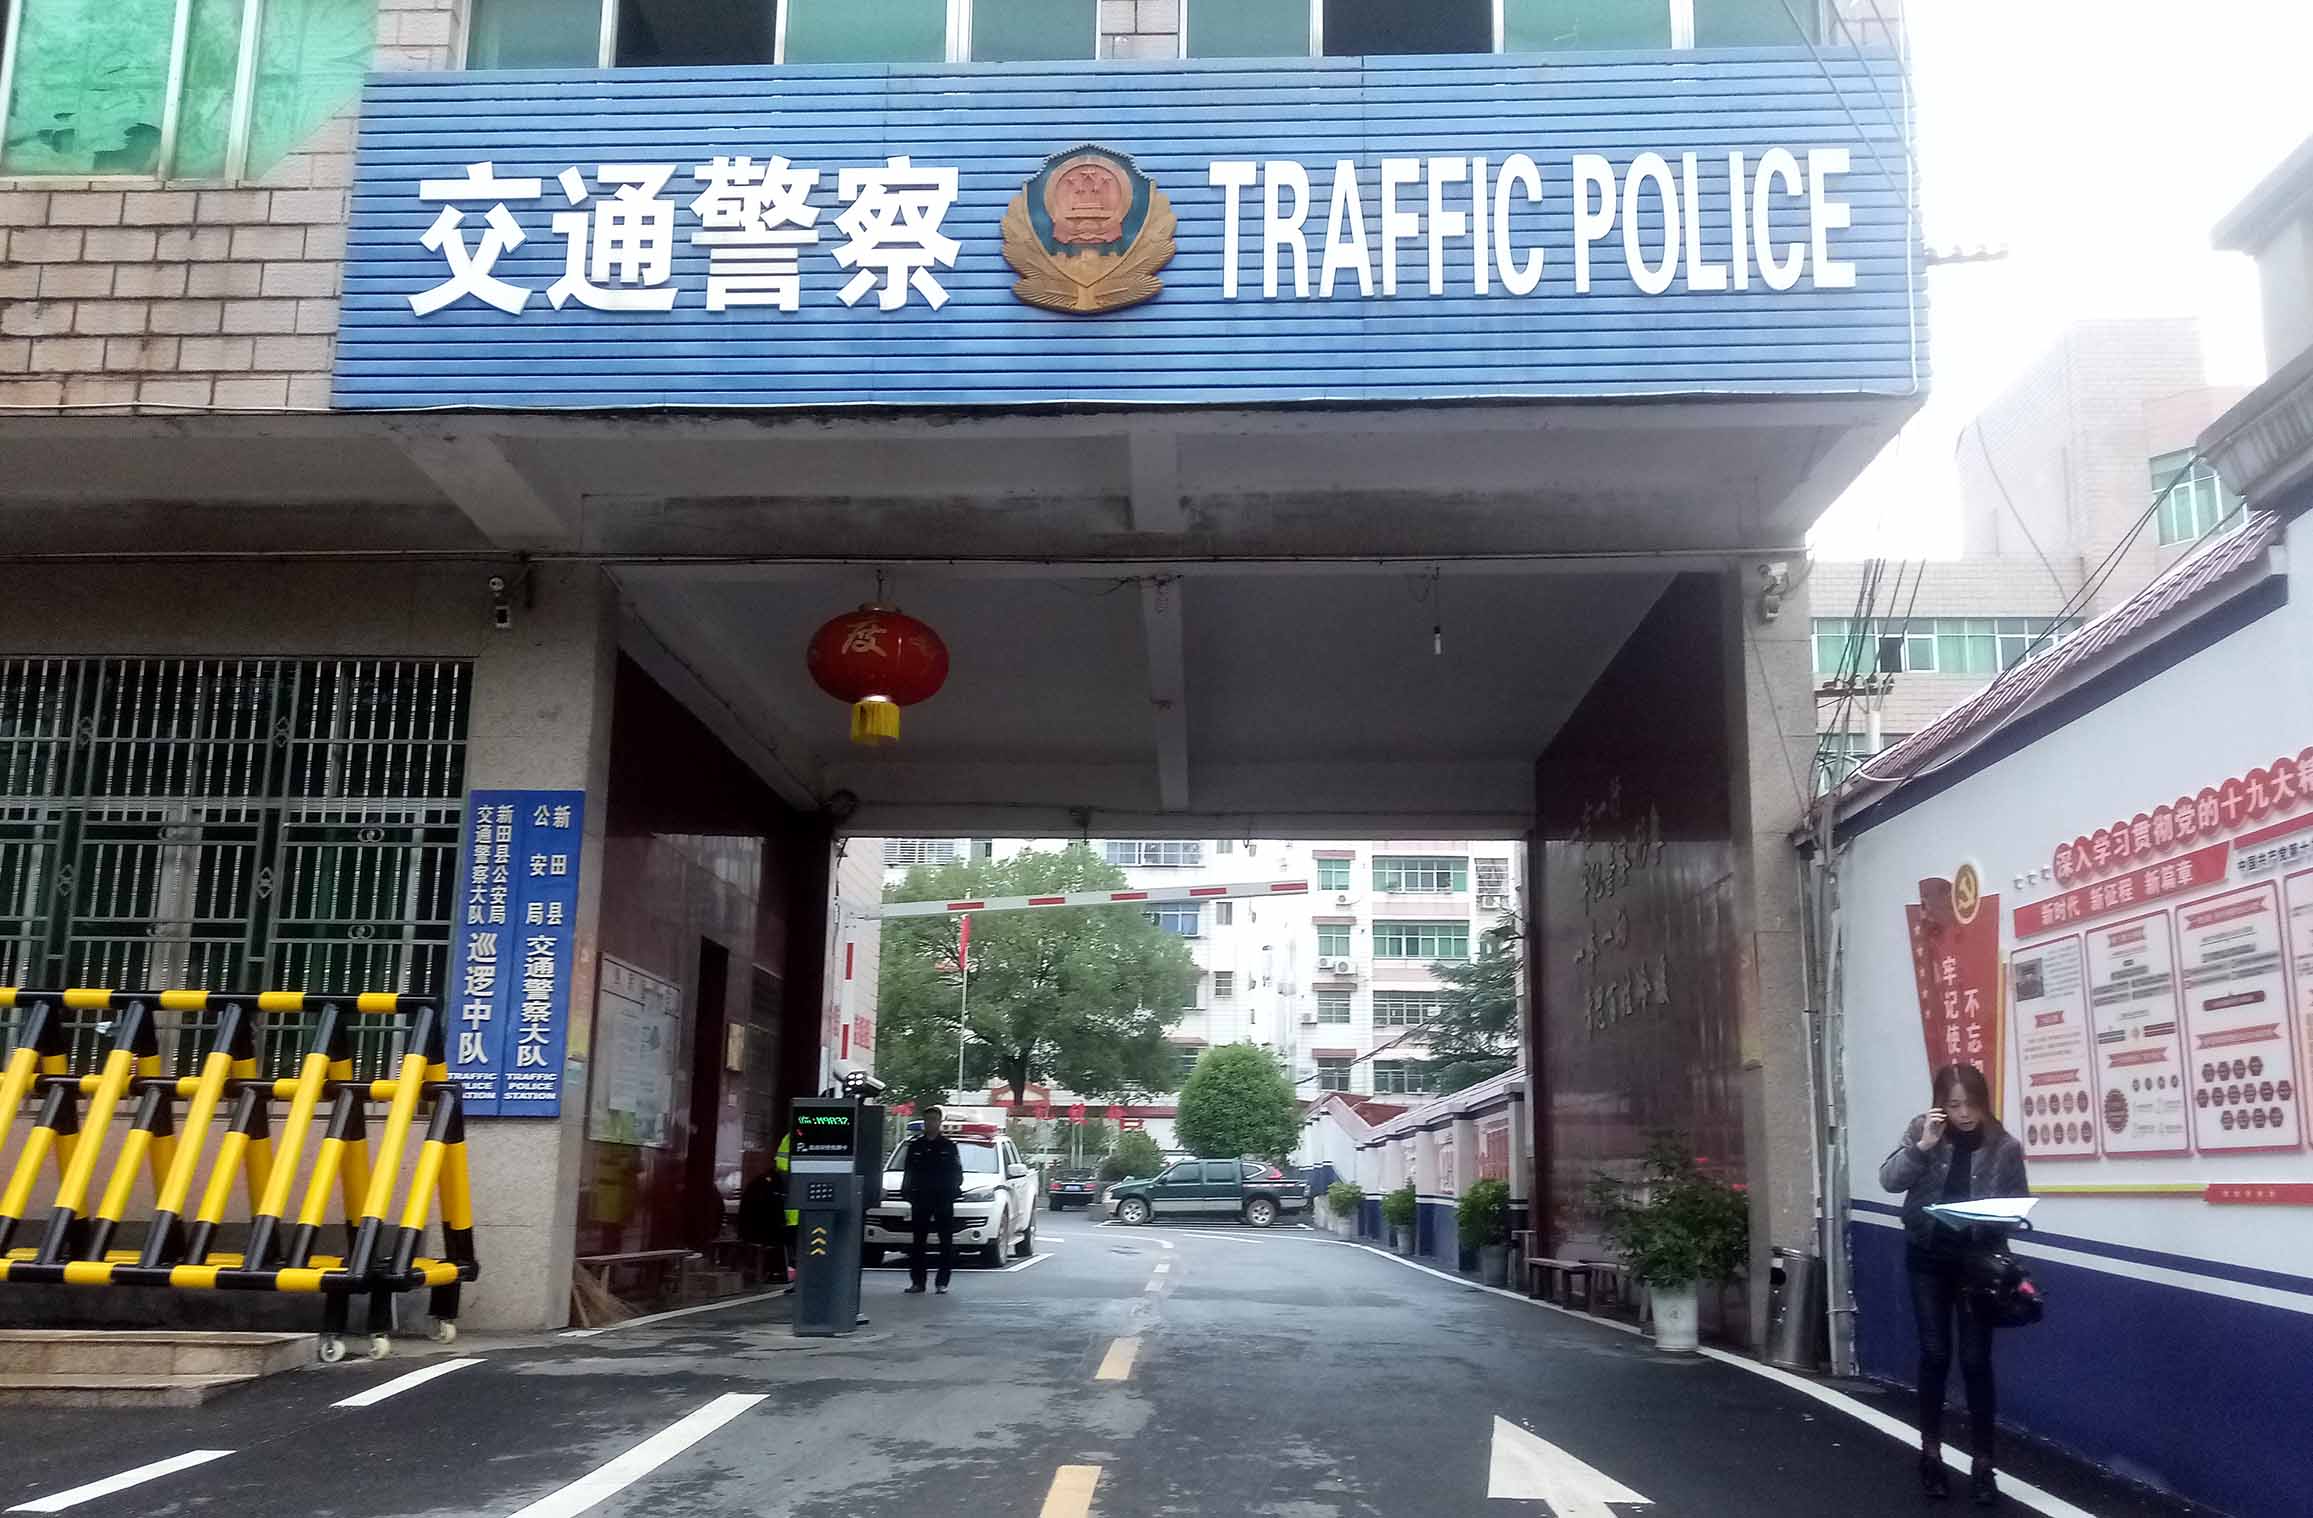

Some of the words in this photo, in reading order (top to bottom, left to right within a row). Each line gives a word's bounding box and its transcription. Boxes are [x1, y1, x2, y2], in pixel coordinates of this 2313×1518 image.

[407, 155, 961, 317] 交通警察
[1208, 153, 1545, 299] TRAFFIC
[1572, 147, 1857, 295] POLICE
[467, 804, 494, 925] 交通警察大队
[488, 804, 514, 925] 新田县公安局
[457, 932, 498, 1065] 巡逻中队
[516, 934, 557, 1067] 交通警察大队
[1941, 955, 1961, 1065] 牢记使
[503, 1092, 556, 1100] STATION
[504, 1072, 557, 1081] TRAFFIC
[508, 1082, 554, 1090] POLICE
